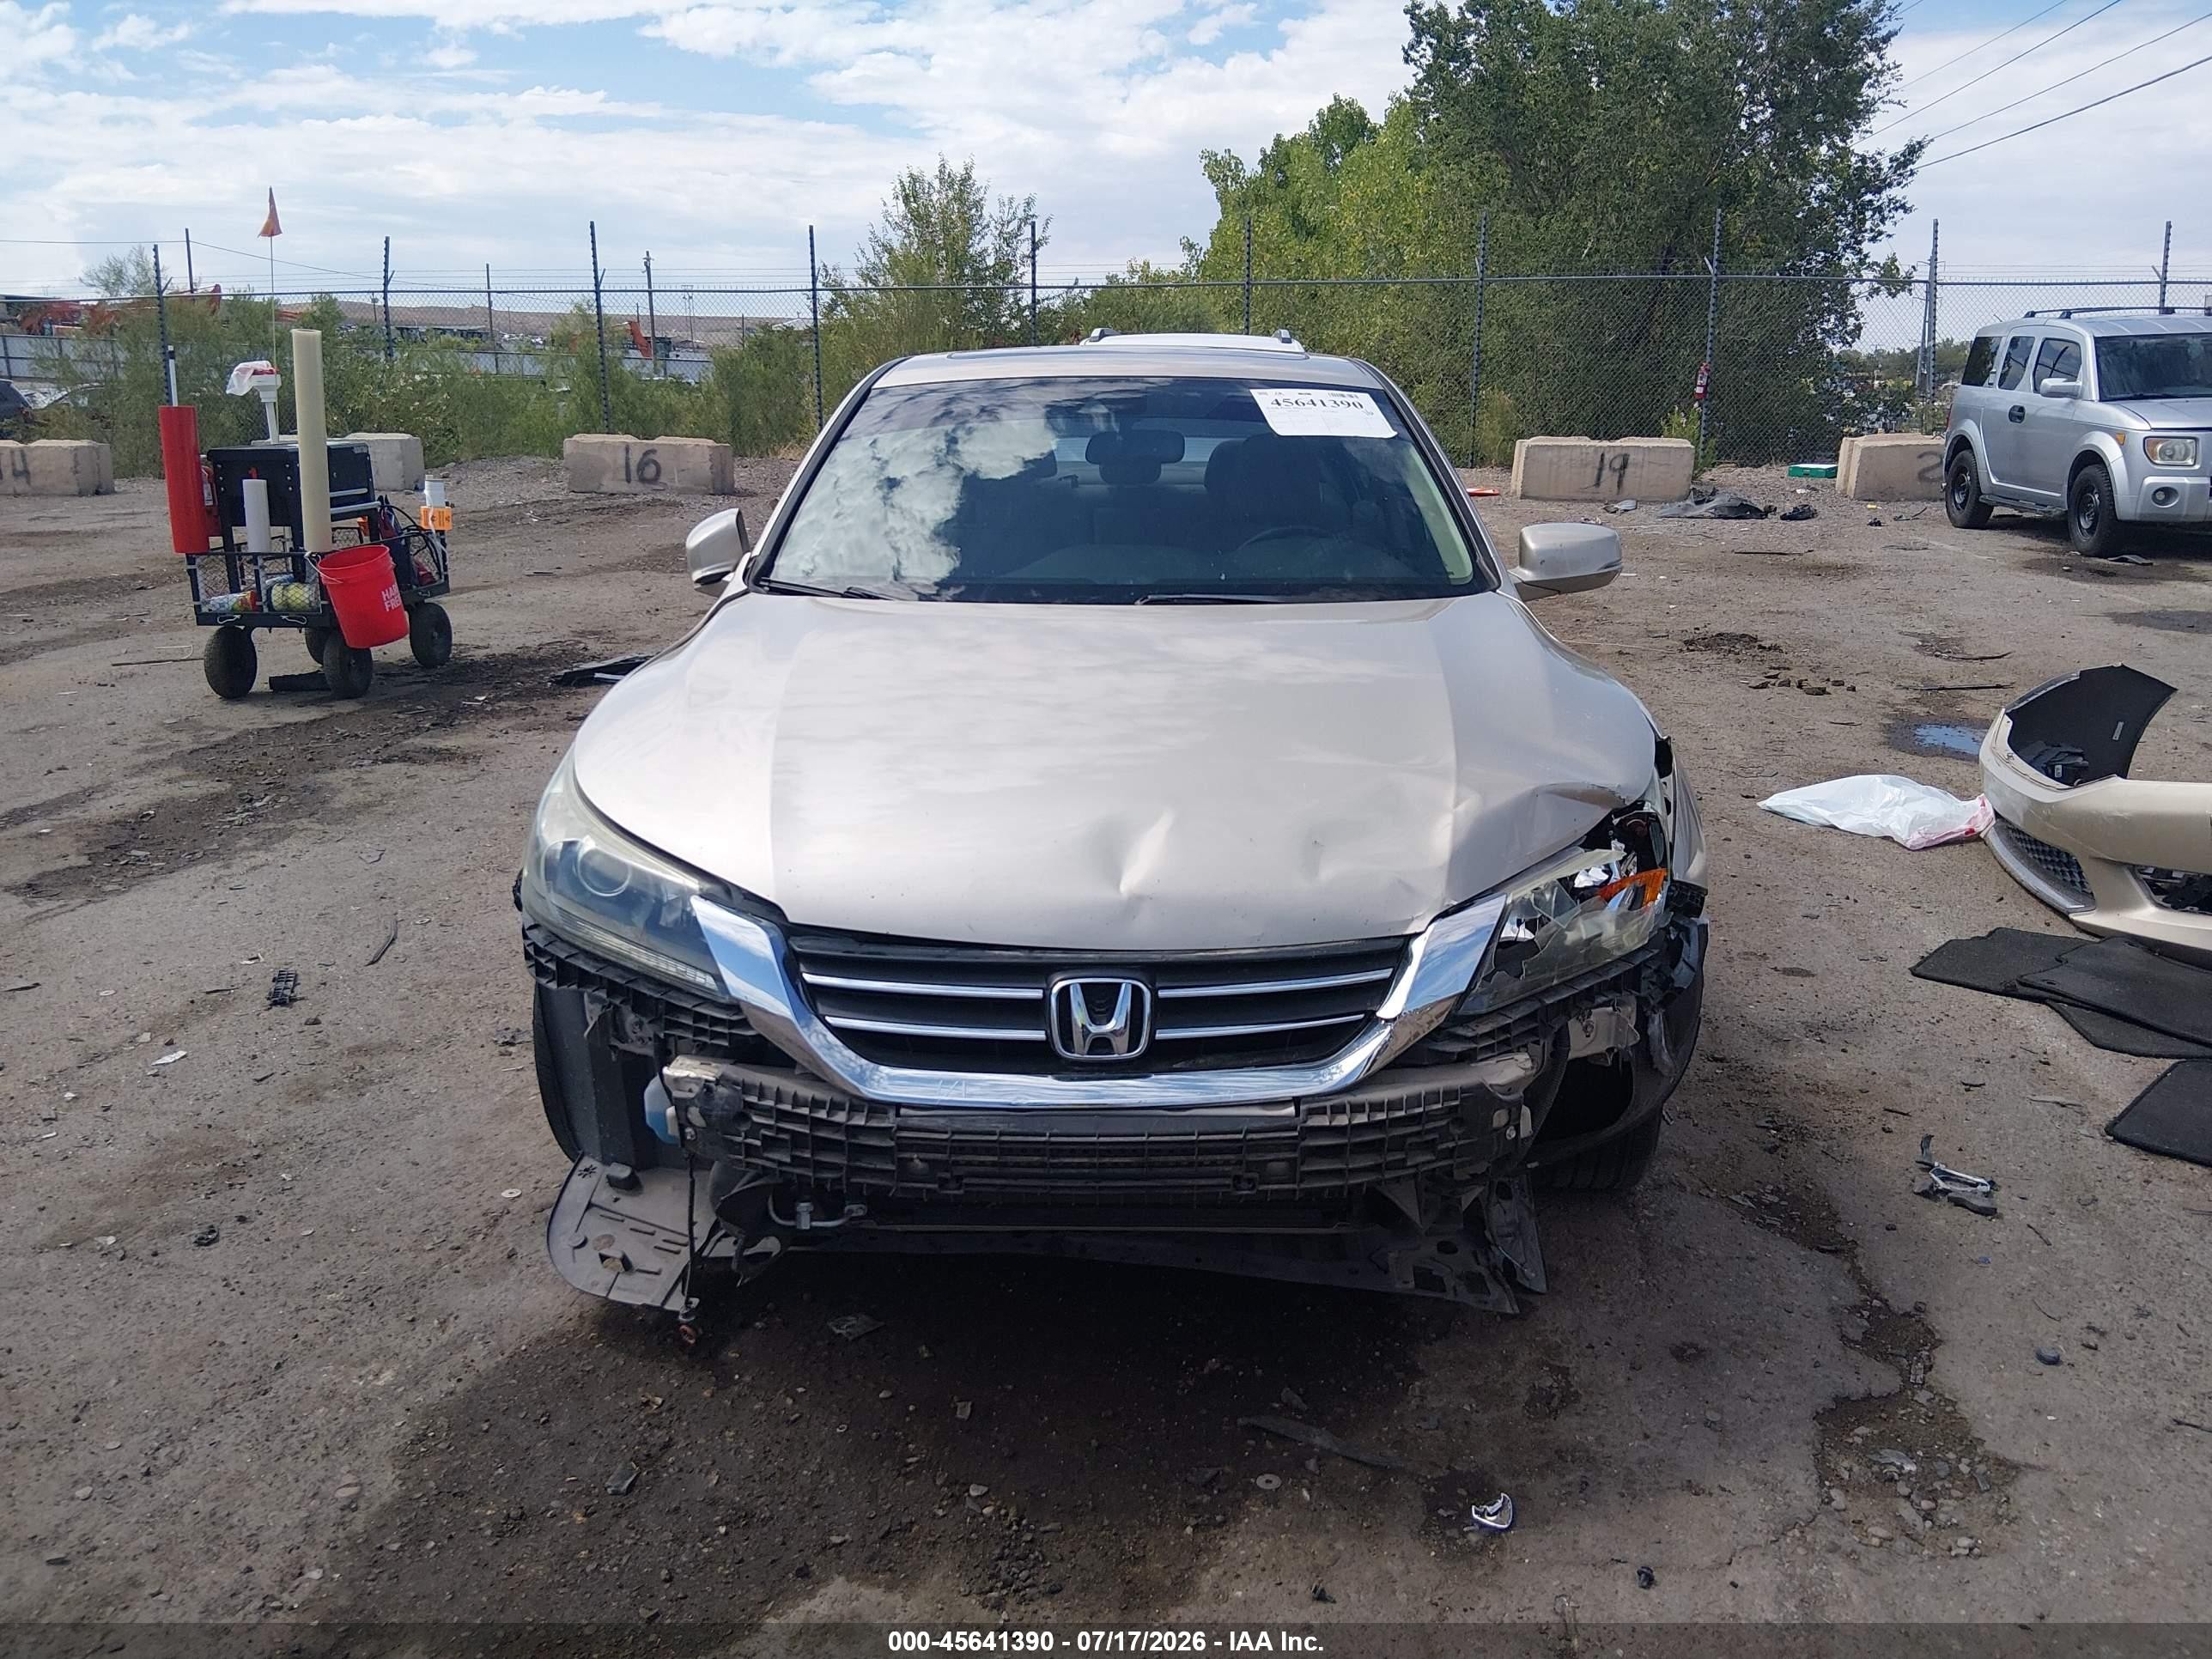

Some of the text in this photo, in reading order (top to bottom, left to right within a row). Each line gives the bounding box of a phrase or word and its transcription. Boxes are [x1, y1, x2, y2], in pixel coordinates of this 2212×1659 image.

[1271, 398, 1364, 410] 45641390
[625, 444, 661, 484] 16
[1595, 452, 1630, 495] 19
